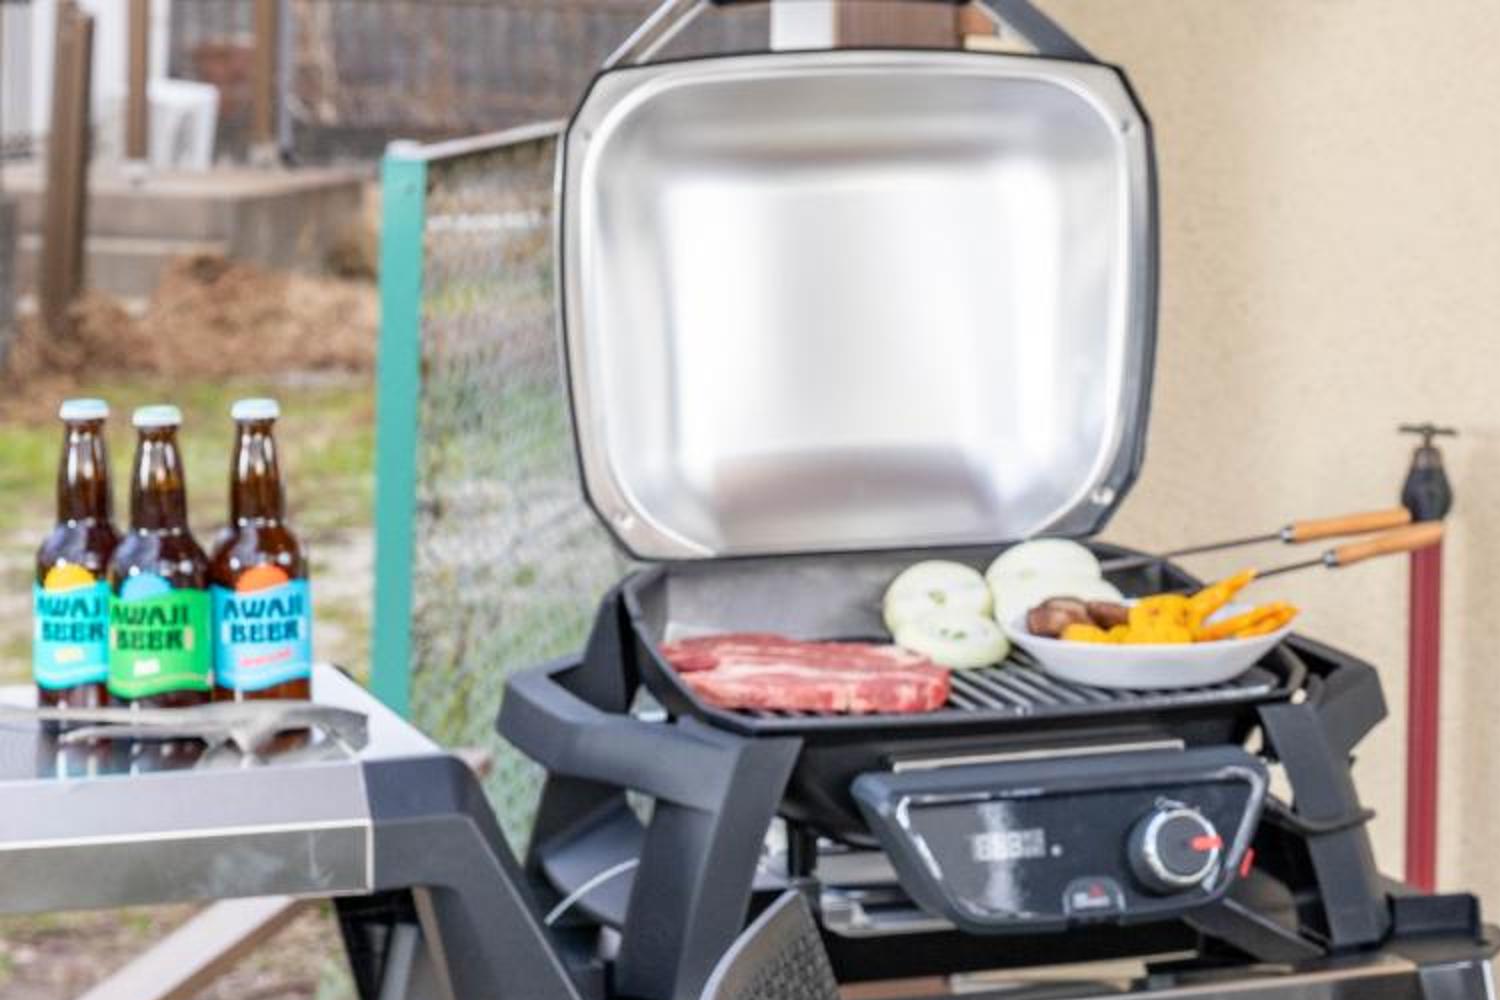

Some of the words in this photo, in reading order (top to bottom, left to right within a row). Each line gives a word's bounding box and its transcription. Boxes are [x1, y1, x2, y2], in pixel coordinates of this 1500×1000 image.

[38, 597, 106, 617] AWAJ
[111, 604, 189, 625] AWAJI
[223, 593, 302, 619] AWAJI
[117, 631, 183, 650] BEER
[231, 621, 298, 643] BEER
